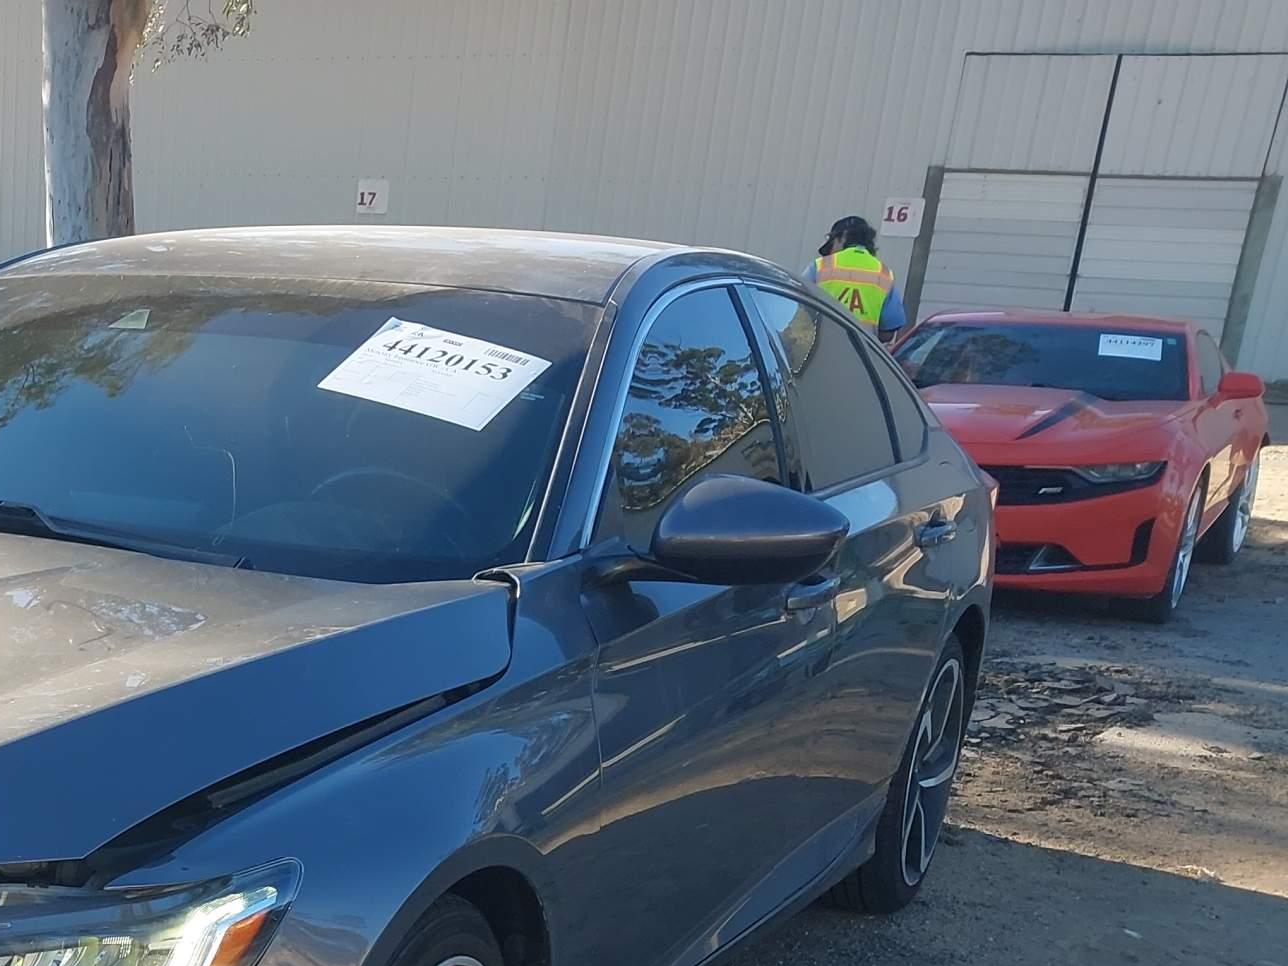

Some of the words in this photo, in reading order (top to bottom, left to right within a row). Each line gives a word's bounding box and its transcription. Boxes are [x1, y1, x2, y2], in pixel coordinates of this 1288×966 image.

[358, 191, 377, 206] 17
[883, 206, 909, 223] 16
[382, 339, 513, 381] 44120153
